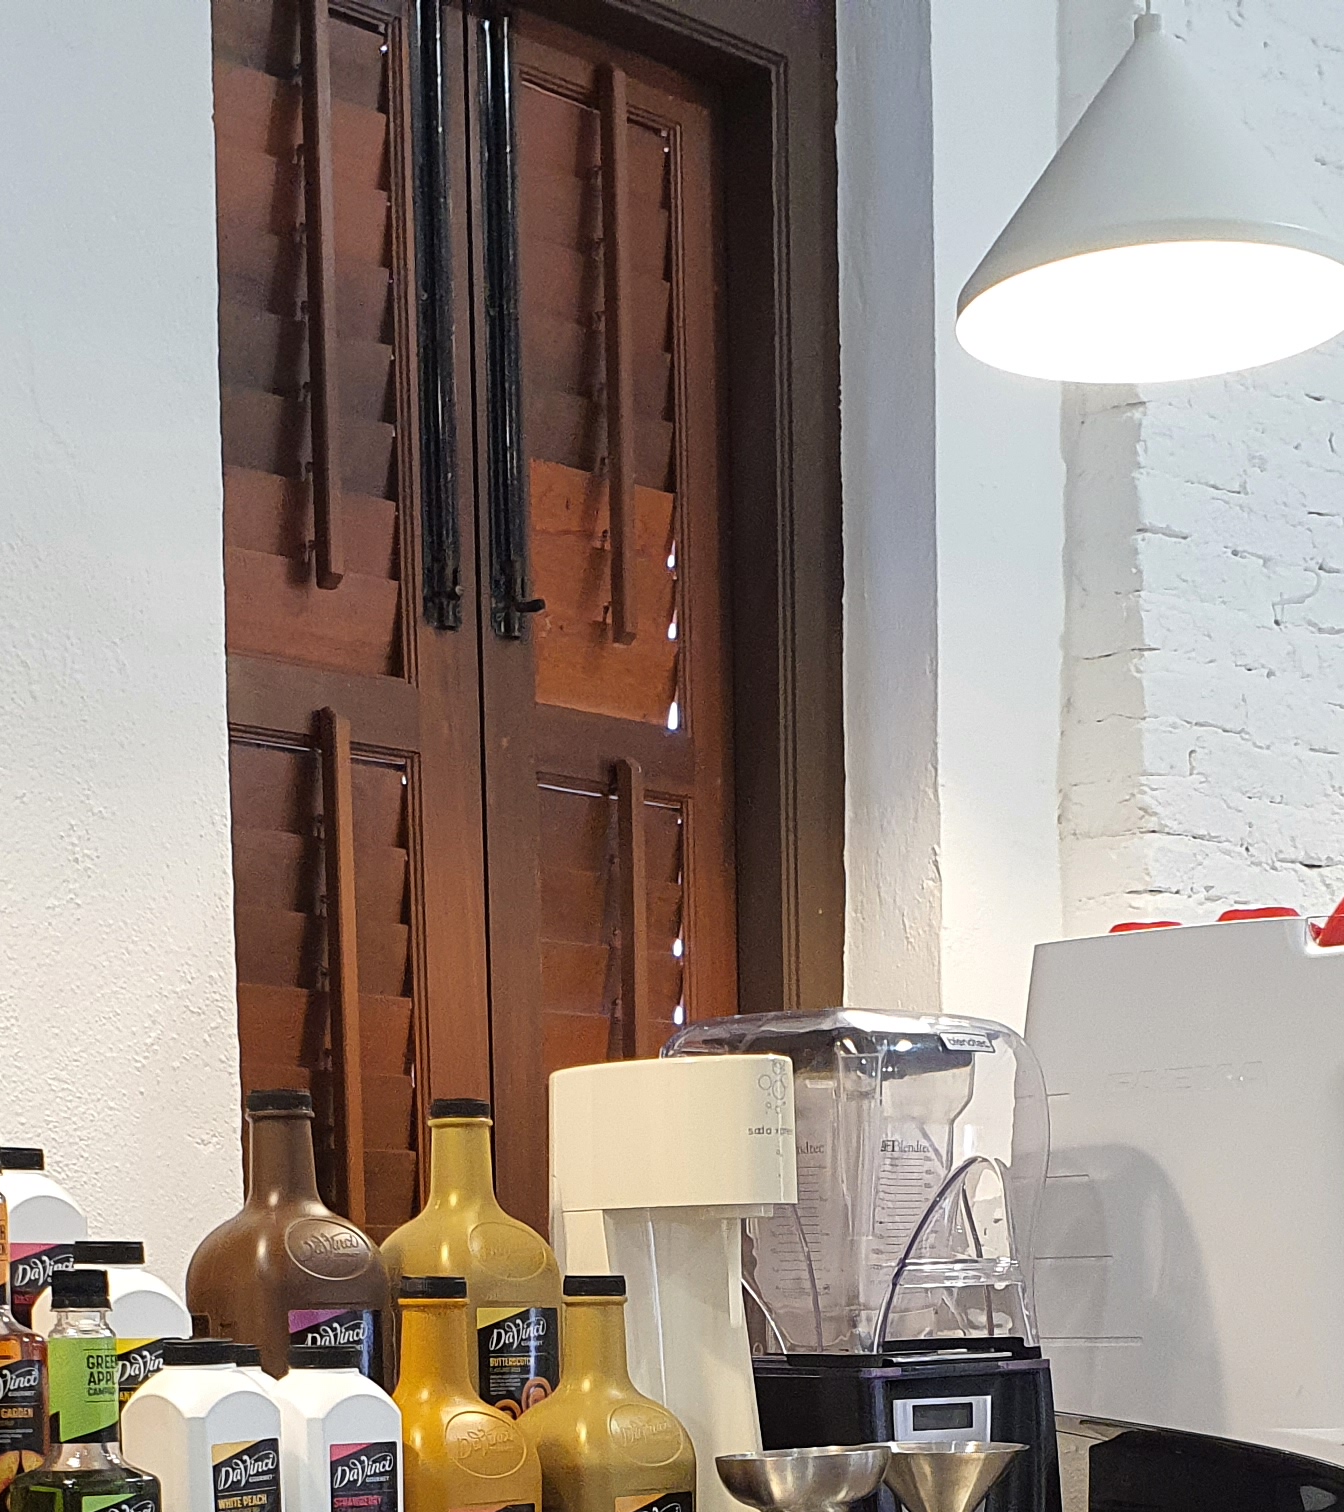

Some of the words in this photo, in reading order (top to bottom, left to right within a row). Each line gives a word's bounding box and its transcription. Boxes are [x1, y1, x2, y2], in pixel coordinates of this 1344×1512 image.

[489, 1317, 547, 1350] DaVinci
[218, 1450, 276, 1490] DaVinci
[334, 1453, 393, 1488] DaVinci
[218, 1497, 242, 1509] WHITE
[243, 1494, 267, 1507] PEACH
